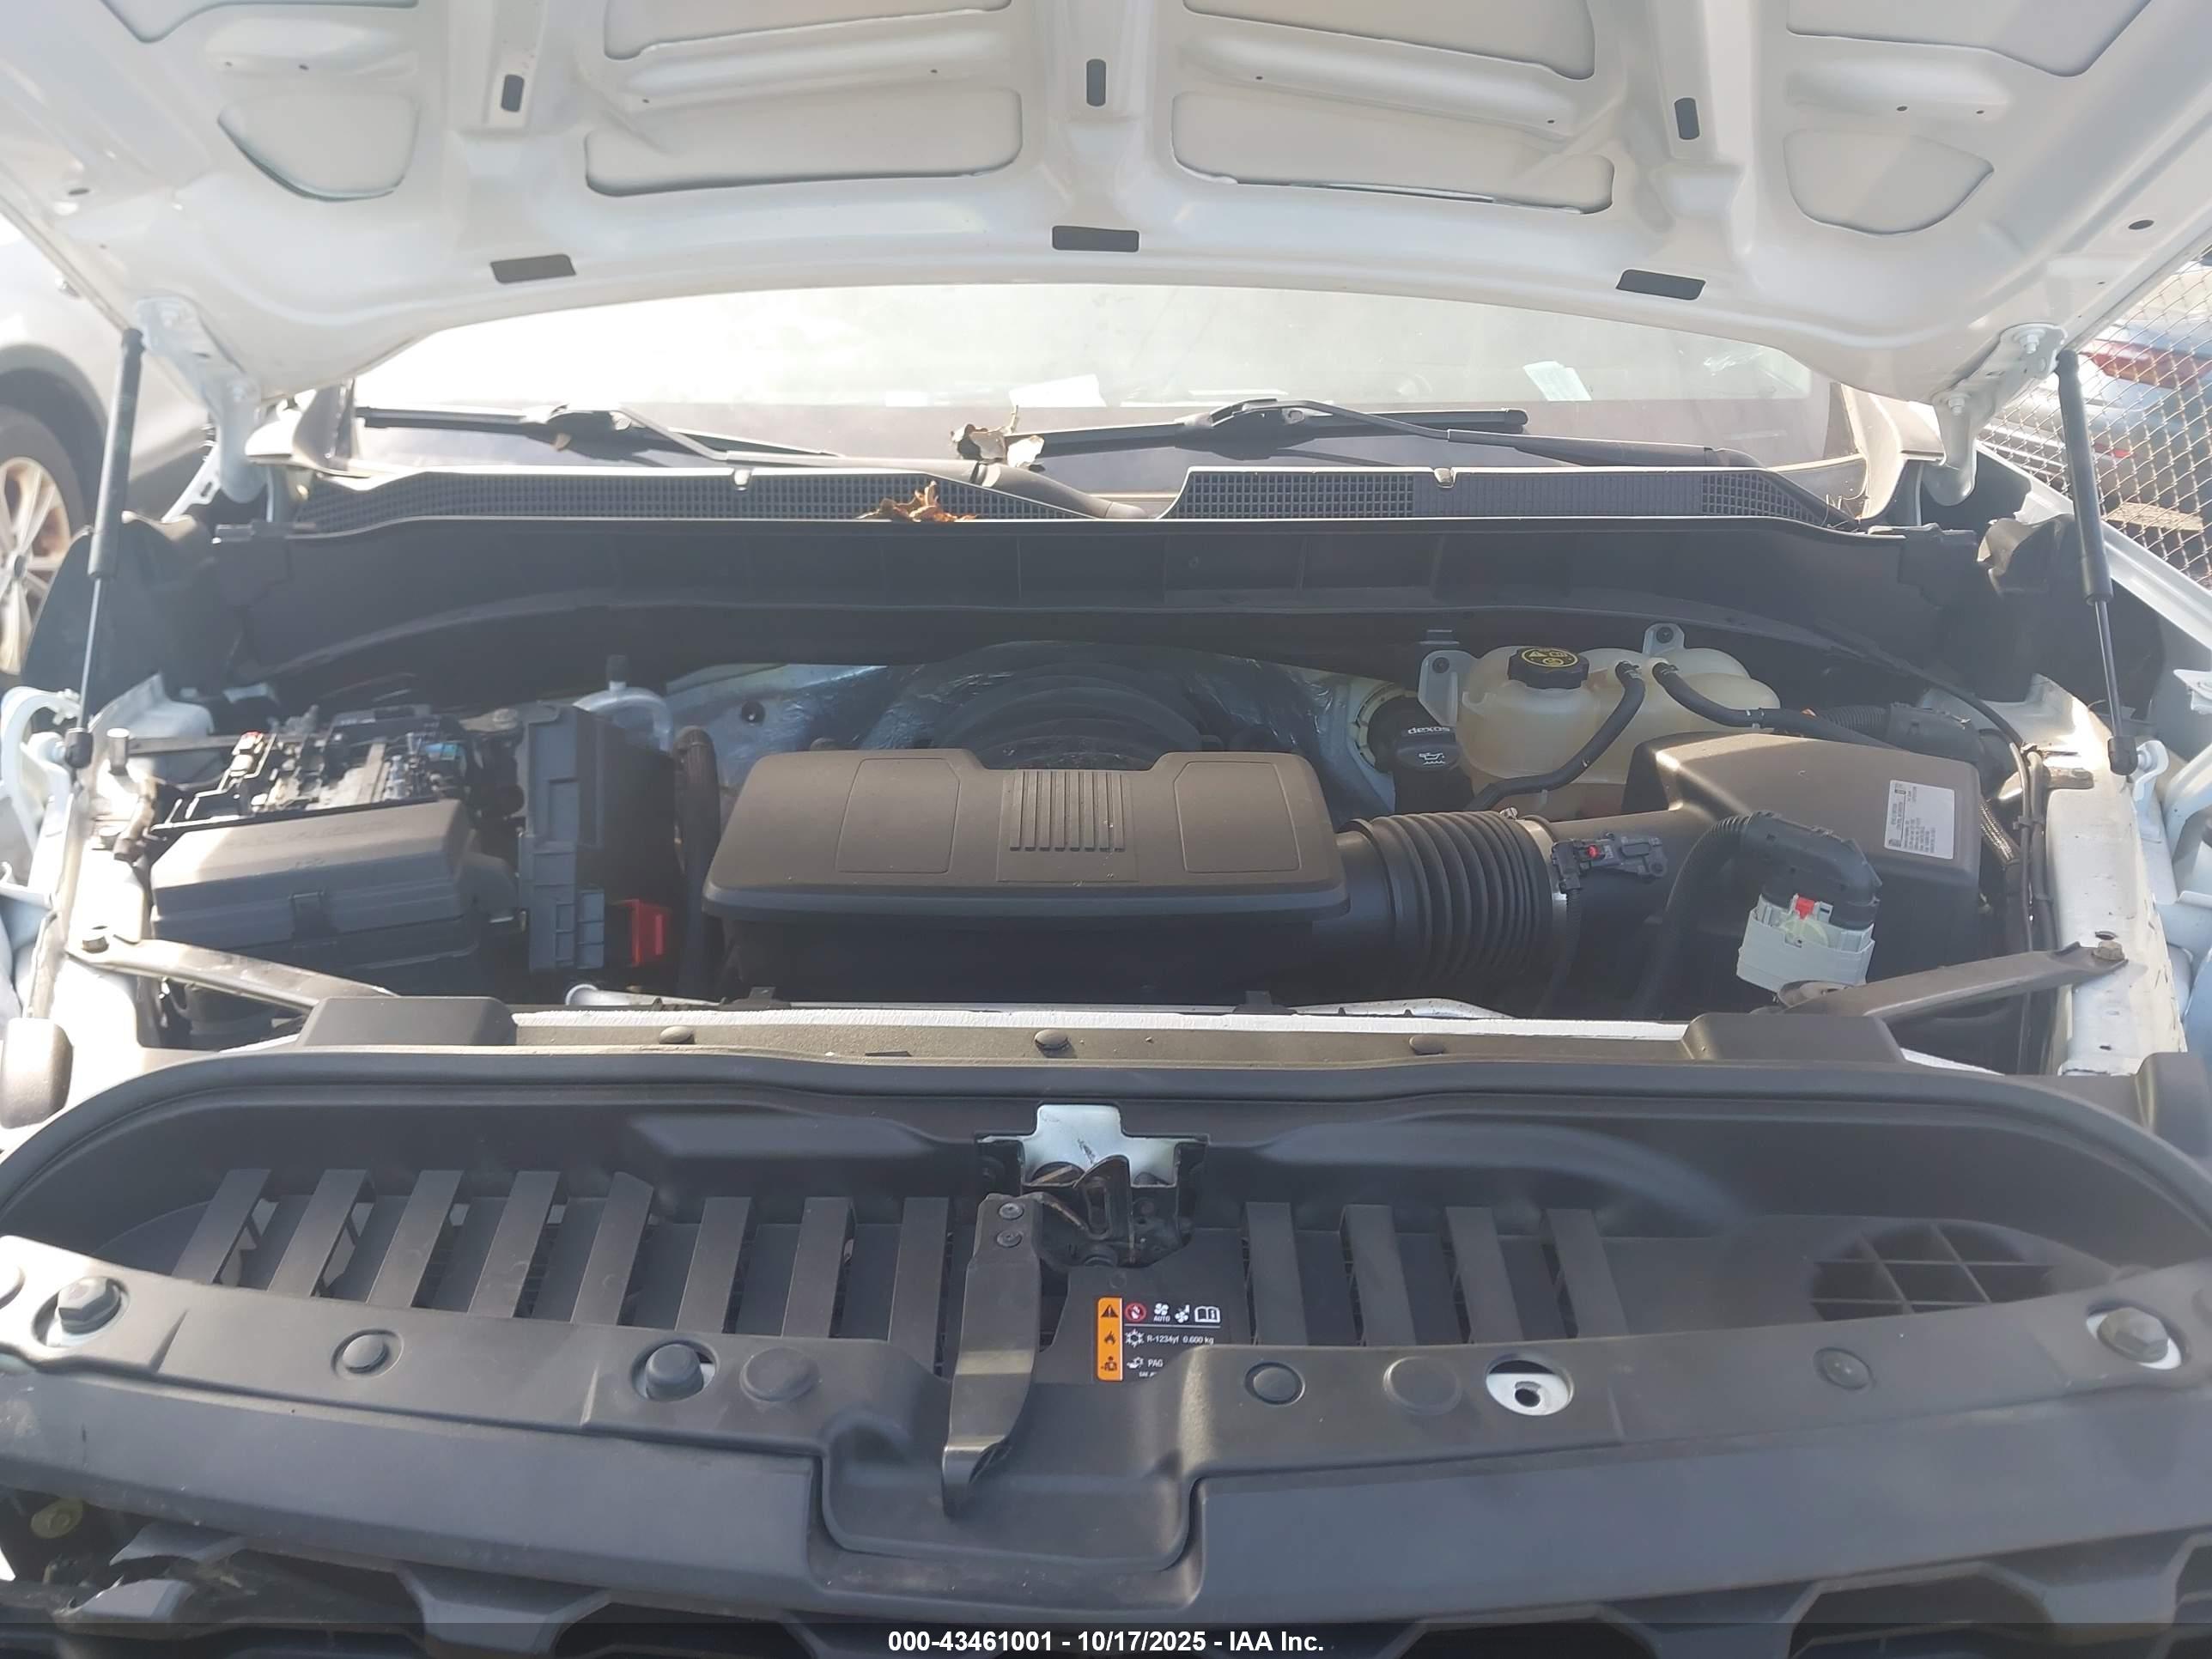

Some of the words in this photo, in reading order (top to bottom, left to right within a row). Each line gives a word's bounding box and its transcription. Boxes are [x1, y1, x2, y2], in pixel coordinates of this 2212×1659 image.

[1146, 1334, 1179, 1344] R-1234yf
[1204, 1336, 1214, 1345] kg
[1147, 1358, 1164, 1368] PAG
